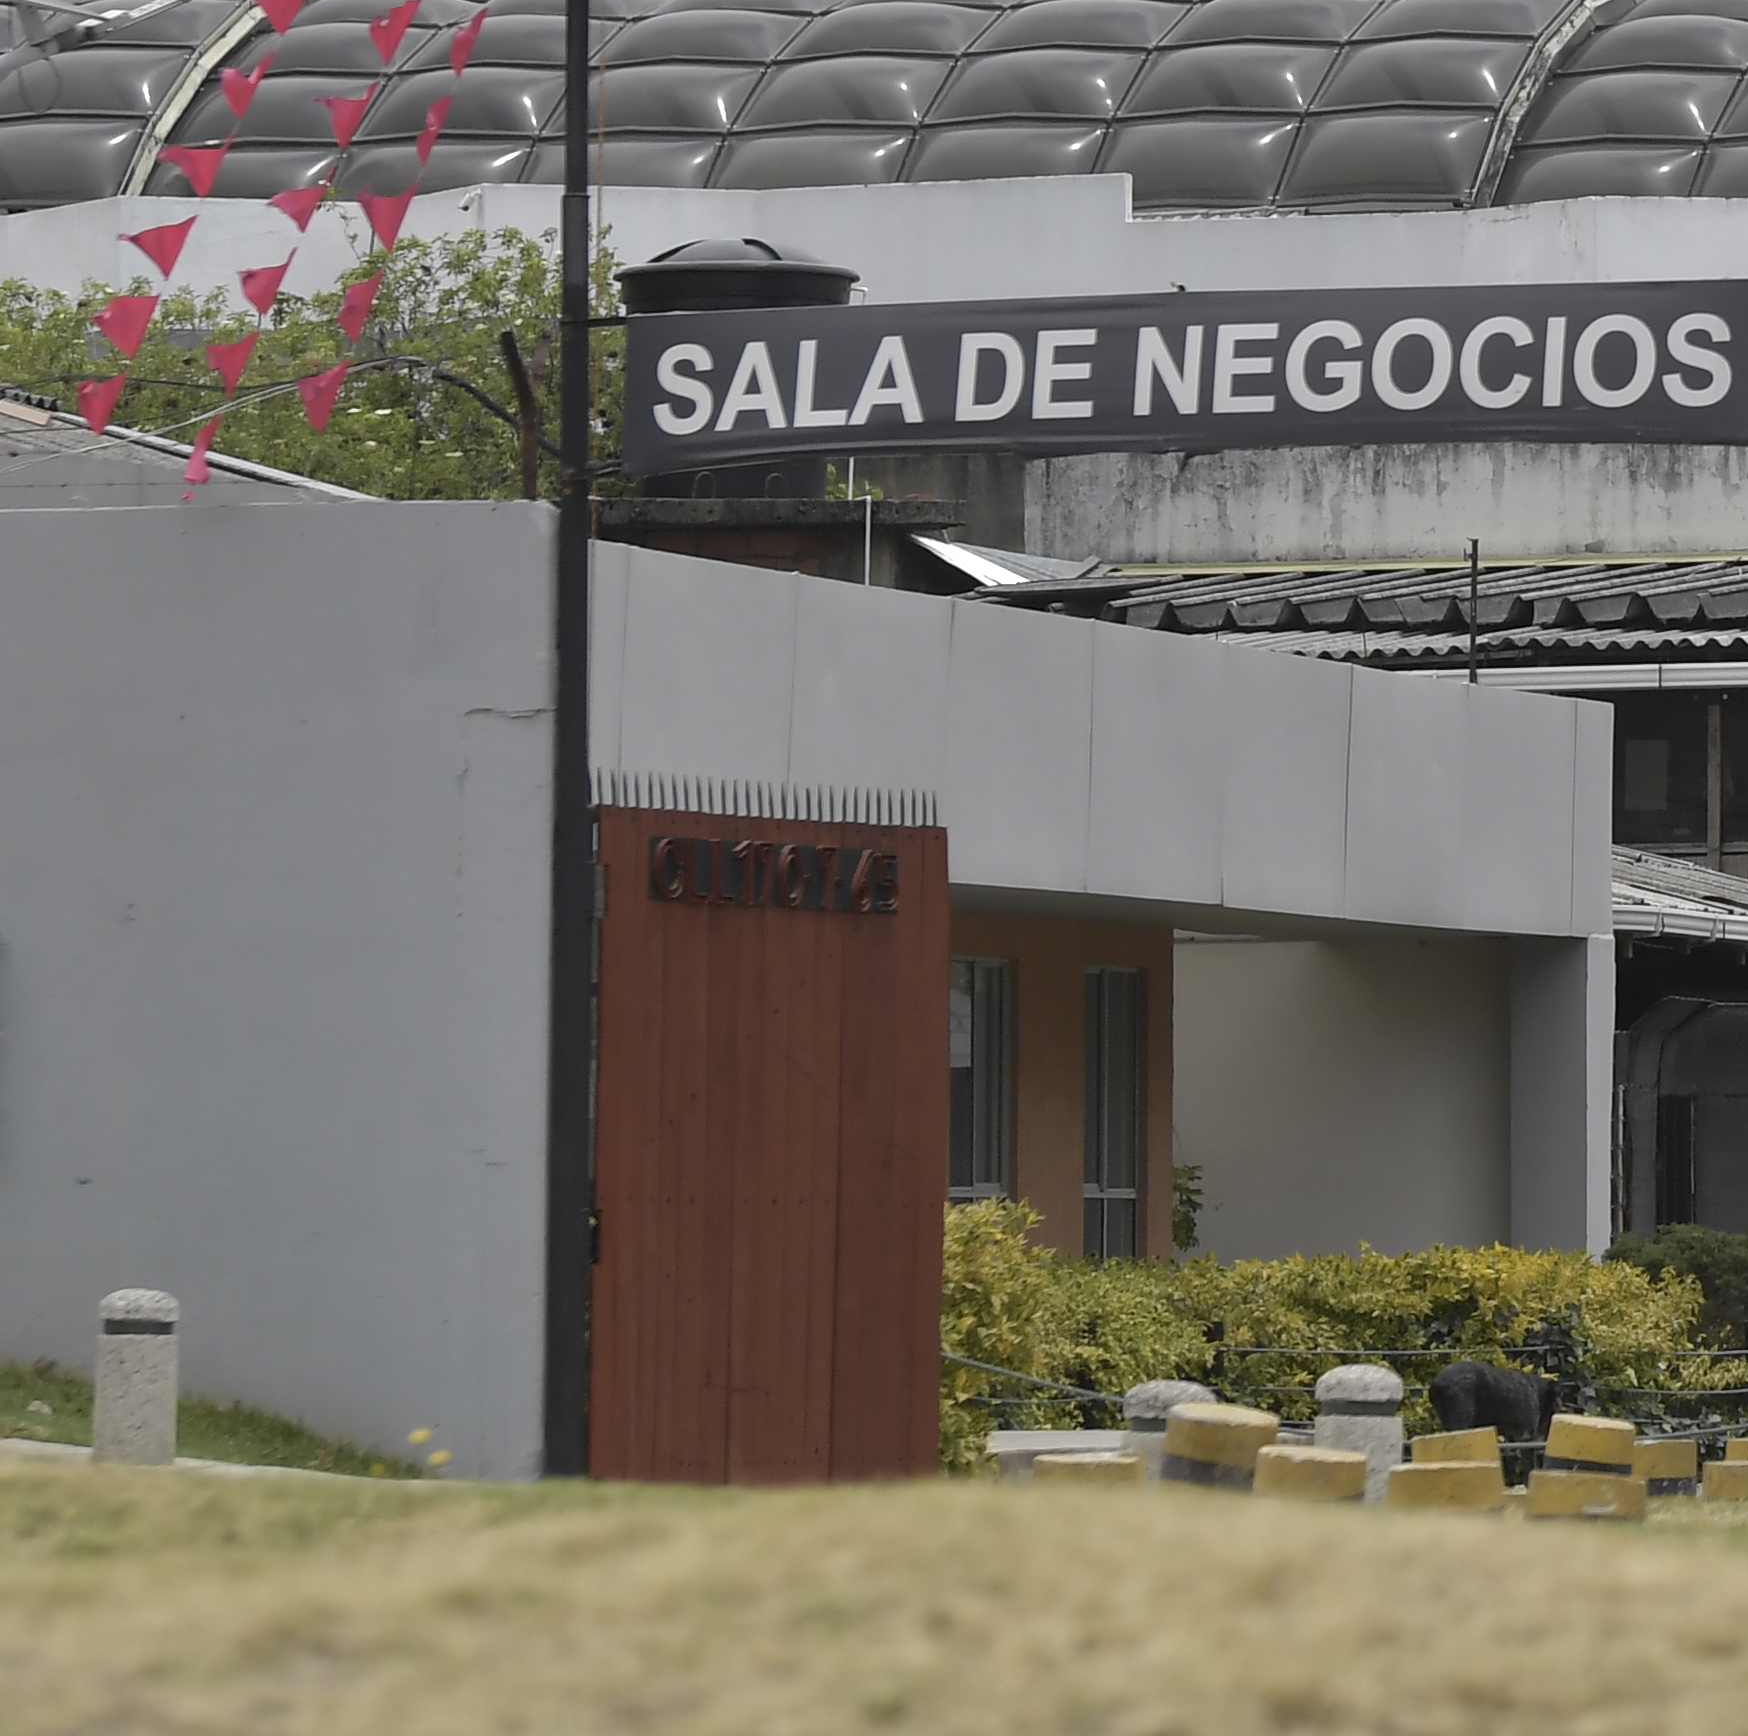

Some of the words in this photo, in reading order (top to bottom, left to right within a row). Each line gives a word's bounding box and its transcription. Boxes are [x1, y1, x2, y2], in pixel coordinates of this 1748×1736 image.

[652, 333, 926, 436] SALA
[954, 327, 1097, 422] DE
[1132, 312, 1733, 417] NEGOCIOS
